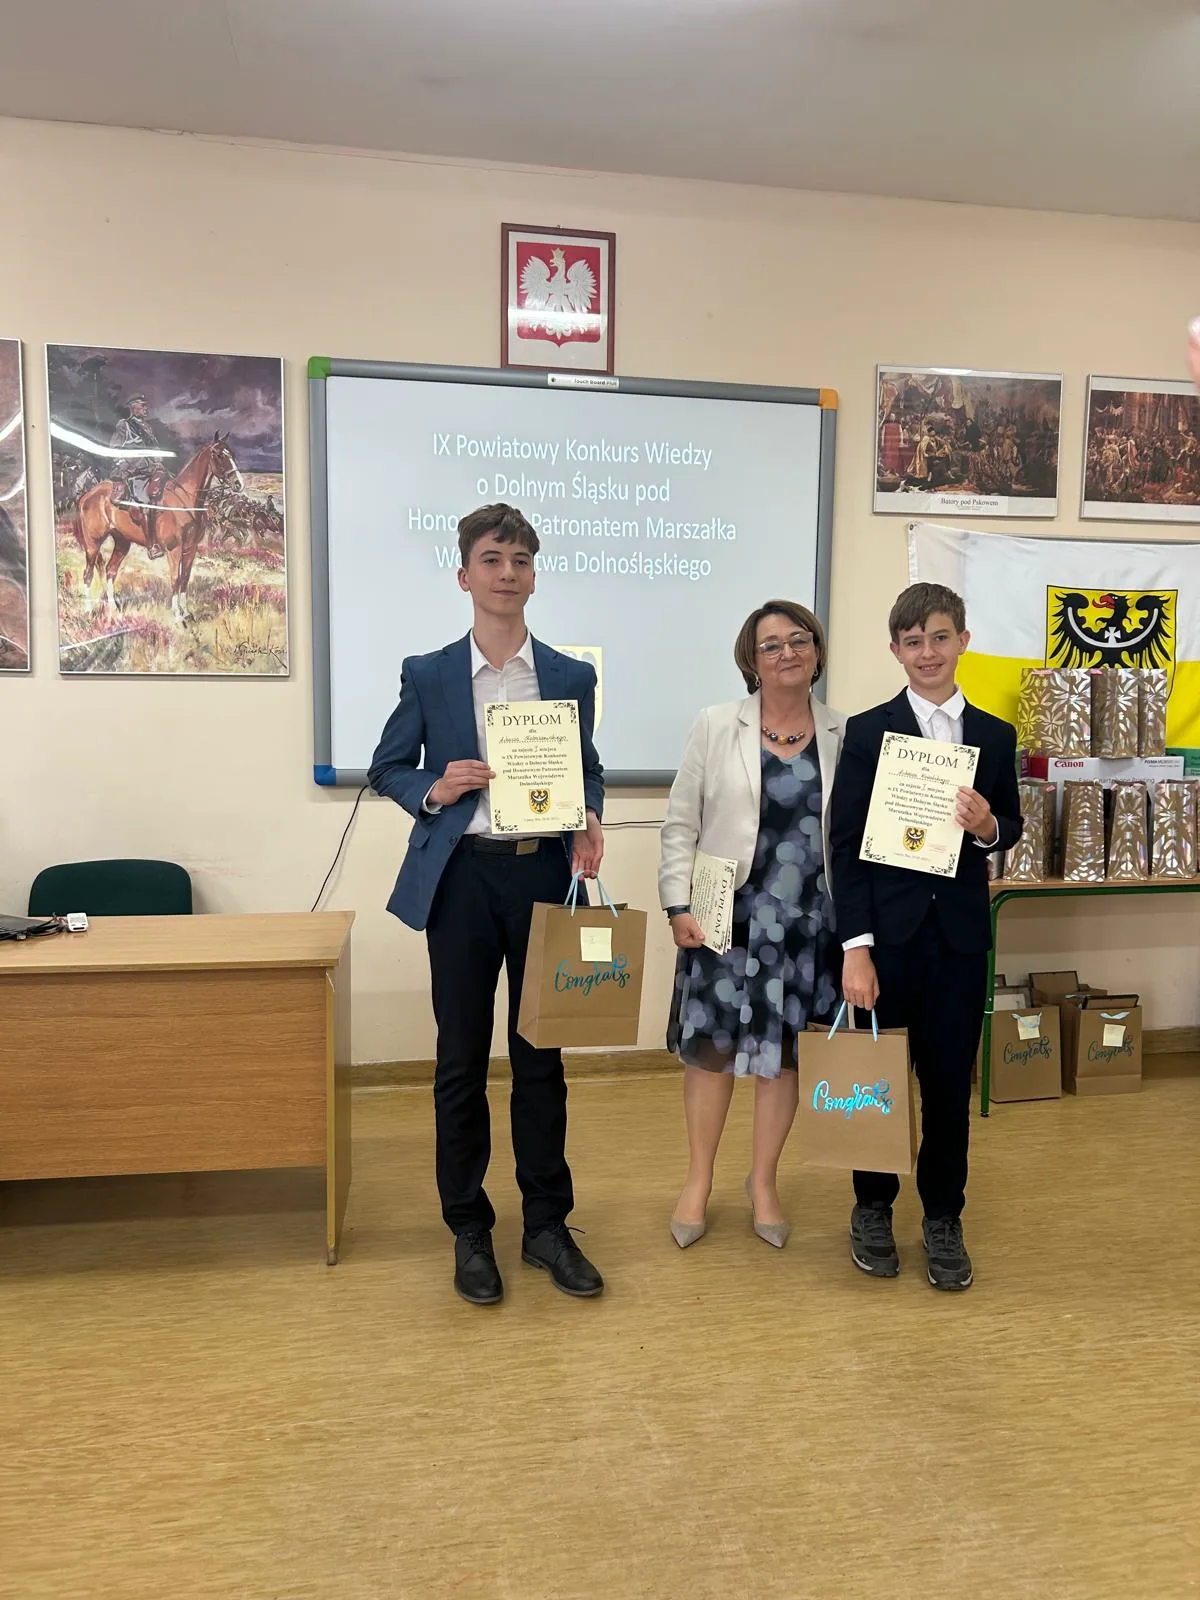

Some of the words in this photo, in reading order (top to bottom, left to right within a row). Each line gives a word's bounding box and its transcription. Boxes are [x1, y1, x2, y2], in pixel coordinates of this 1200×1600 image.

[433, 433, 450, 456] IX
[457, 434, 559, 466] Powiatowy
[566, 439, 639, 464] Konkurs
[645, 441, 713, 470] Wiedzy
[477, 478, 489, 496] o
[495, 473, 565, 503] Dolnym
[572, 471, 629, 504] Śląsku
[636, 478, 670, 506] pod
[532, 513, 639, 538] Patronatem
[646, 516, 737, 540] Marszałka
[575, 551, 712, 581] Dolnośląskiego
[503, 714, 562, 727] DYPLOM
[897, 748, 959, 769] DYPLOM
[1054, 760, 1084, 768] Canon
[900, 789, 929, 798] Powiatowym
[914, 798, 931, 806] Dolnym
[895, 802, 923, 811] Honorowym
[924, 807, 952, 816] Patronatem
[898, 816, 933, 827] Dolnośląskiego
[714, 879, 728, 934] DYPLOM
[554, 952, 631, 996] Congrats
[1003, 1036, 1053, 1066] Congrats
[1087, 1035, 1135, 1064] Congrats
[813, 1079, 894, 1120] Congrats
